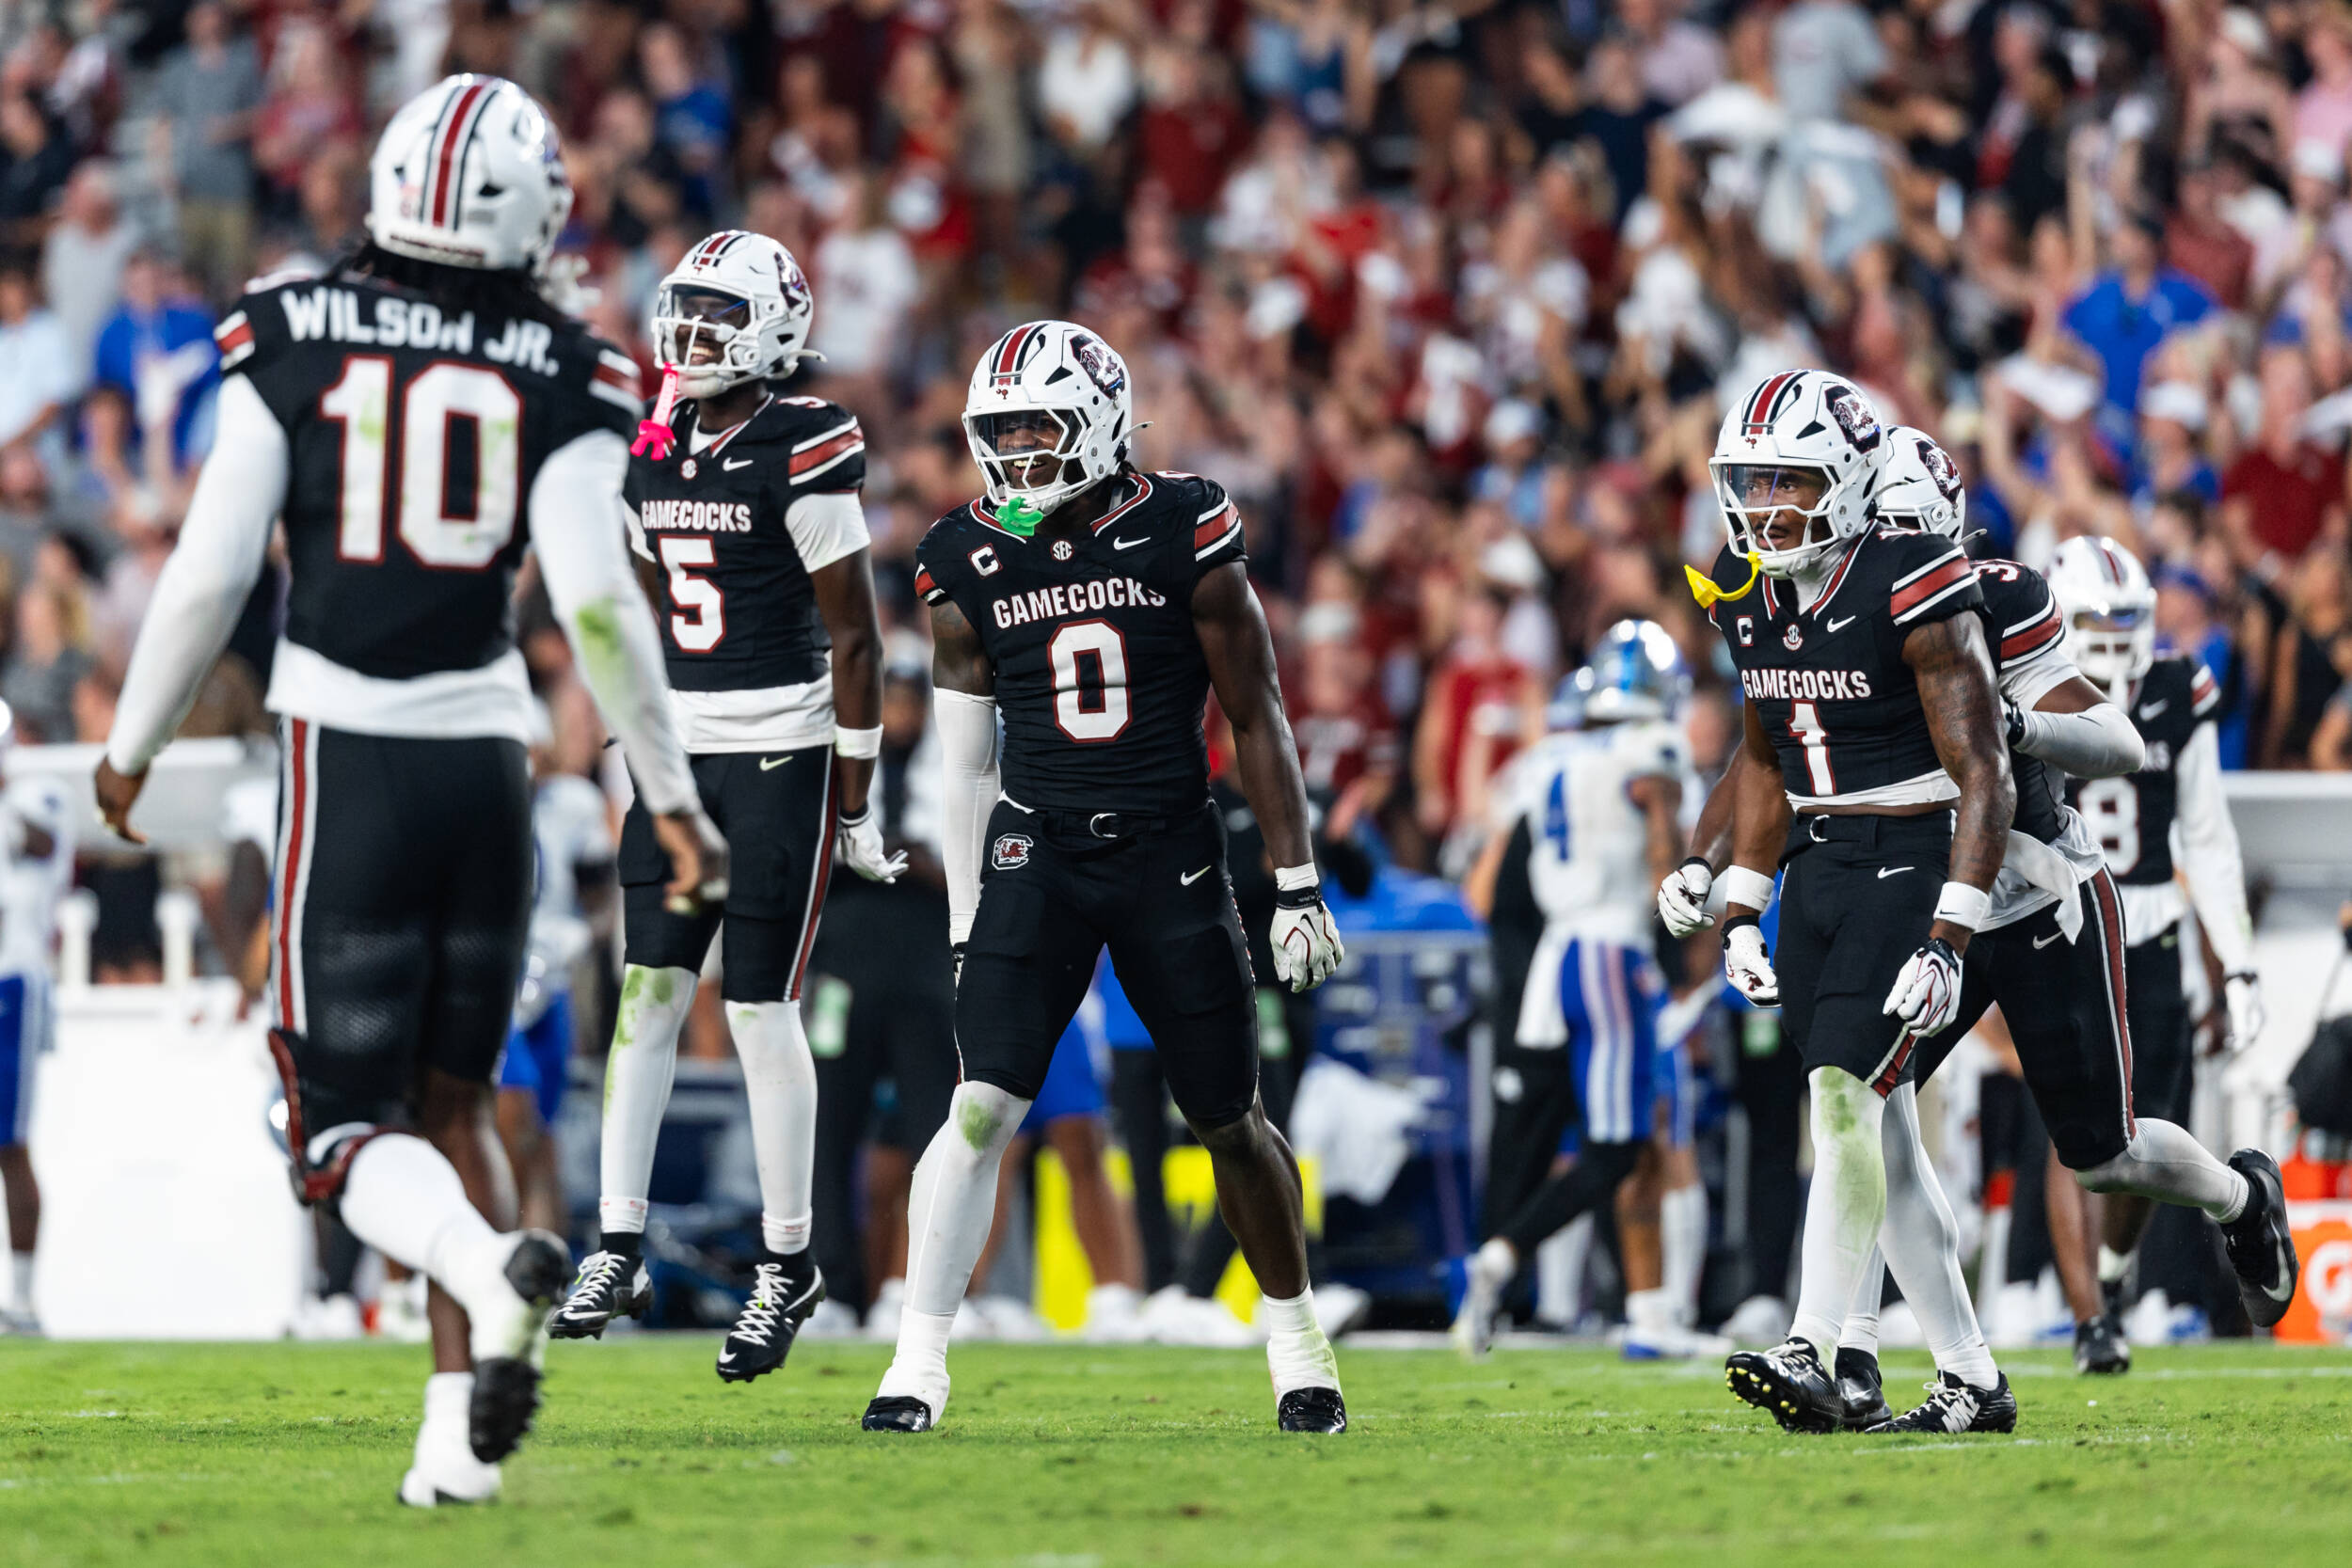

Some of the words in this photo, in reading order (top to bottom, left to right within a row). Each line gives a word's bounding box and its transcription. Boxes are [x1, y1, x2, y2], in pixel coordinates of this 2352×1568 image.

[279, 287, 474, 354] WILSON
[483, 318, 560, 376] JR.
[318, 354, 524, 570] 10
[641, 499, 752, 532] GAMECOCKS
[968, 543, 1003, 578] C
[1052, 540, 1073, 561] SEC
[658, 534, 727, 654] 5
[1737, 615, 1754, 646] C
[1046, 617, 1133, 744] 0
[1741, 669, 1872, 700] GAMECOCKS
[1785, 700, 1836, 797] 1
